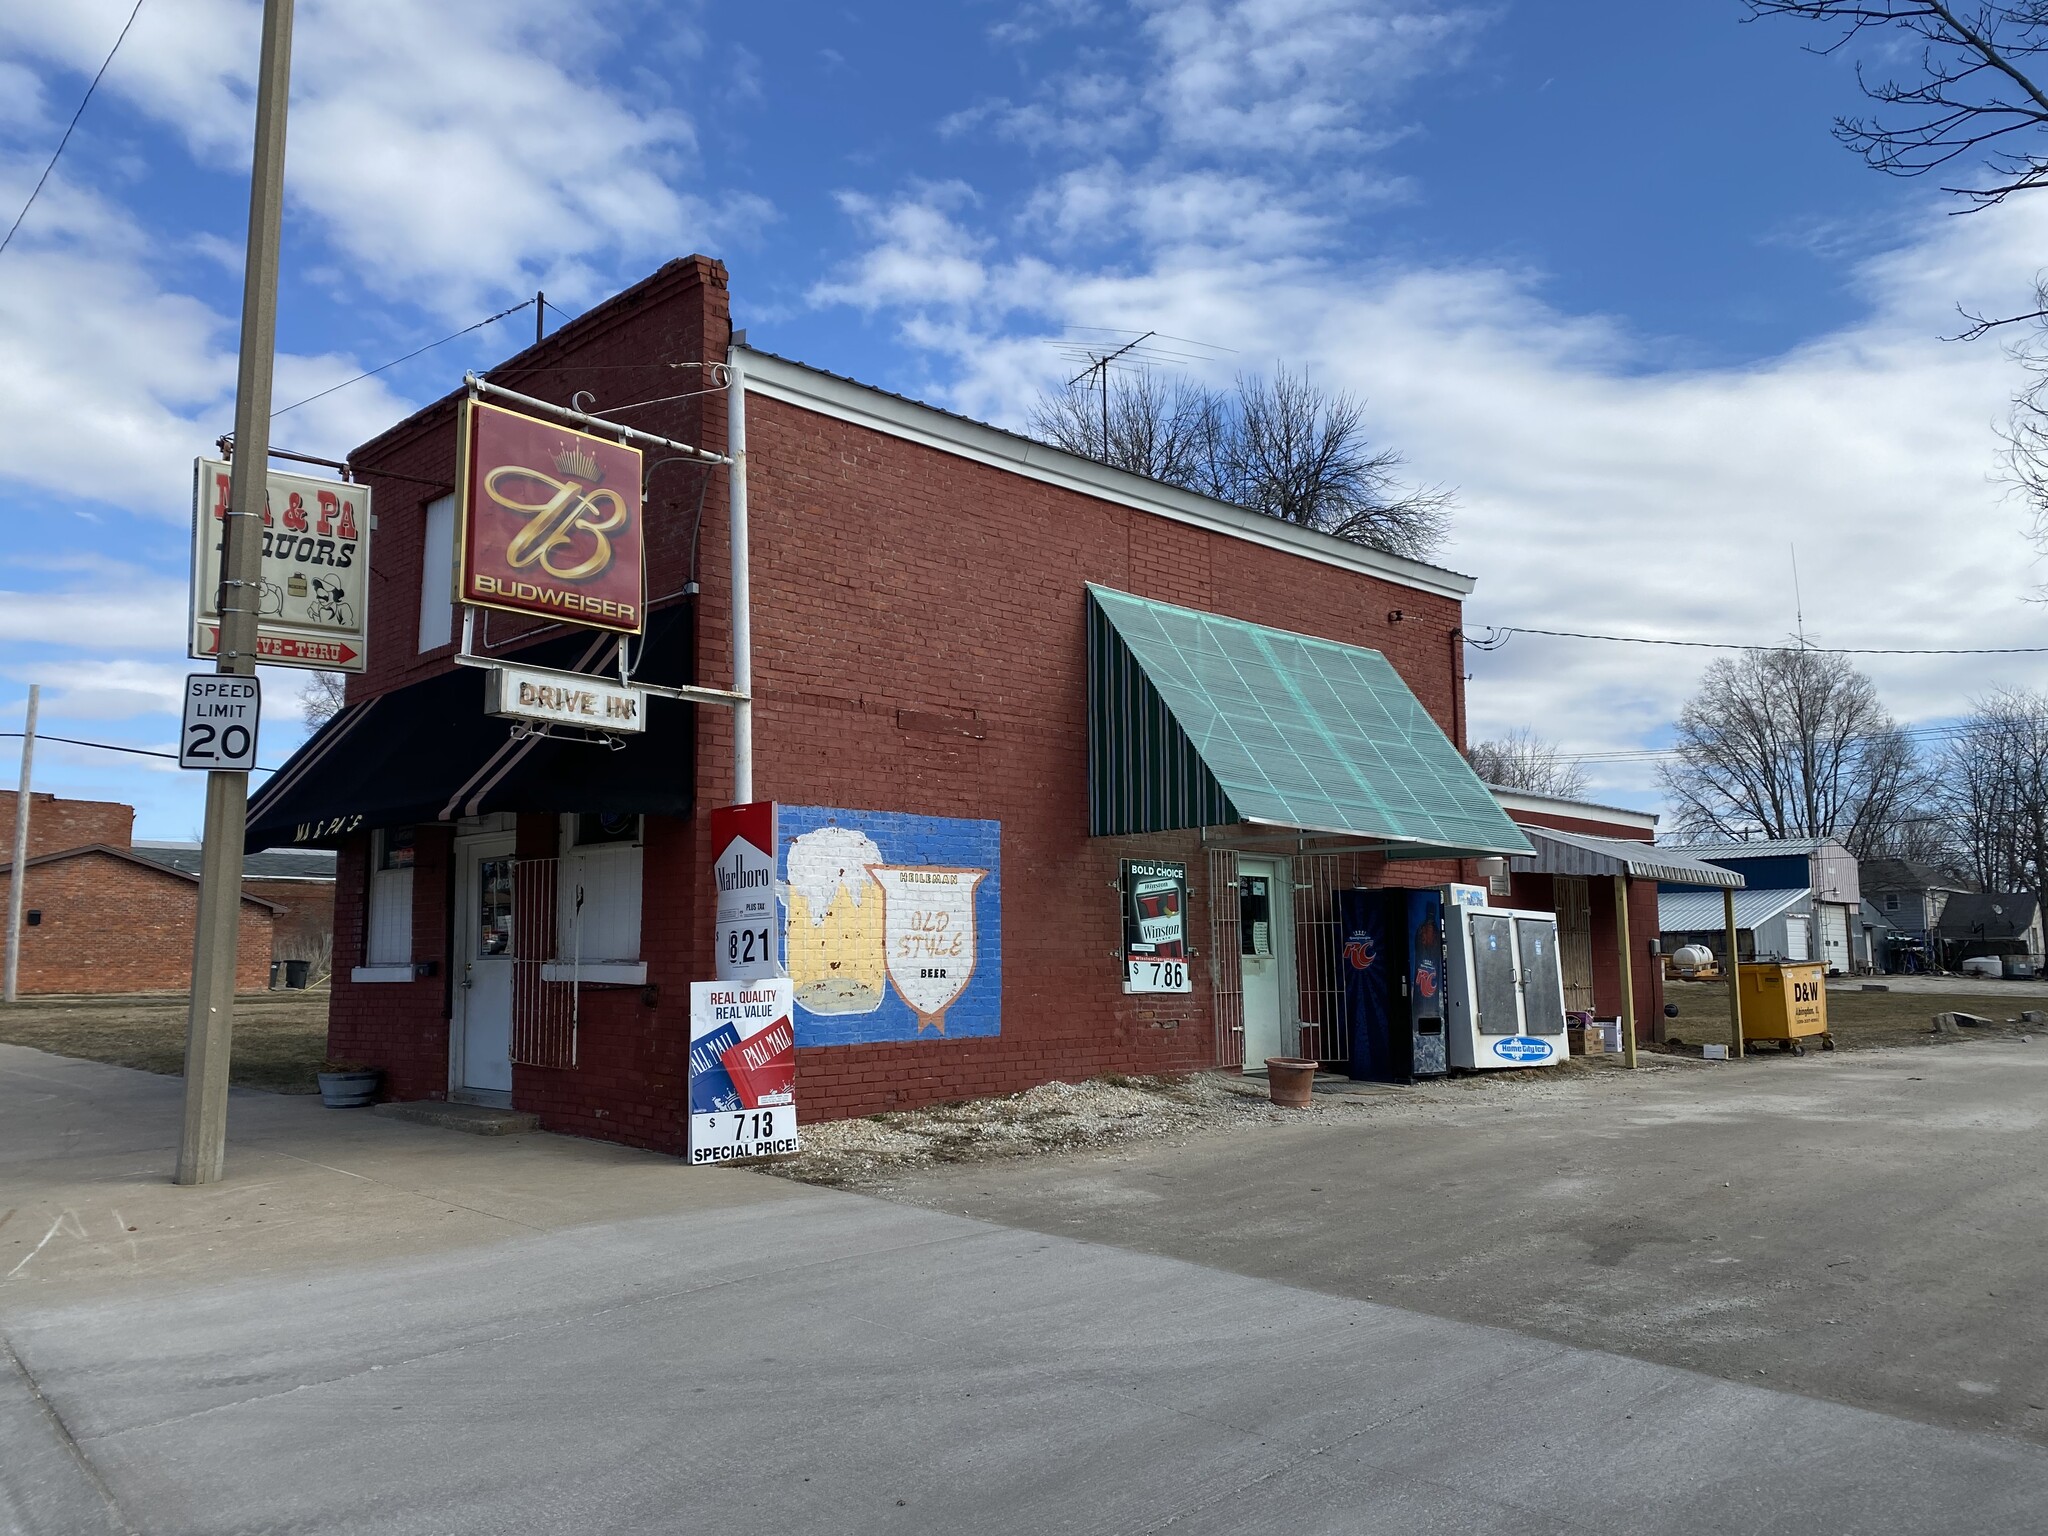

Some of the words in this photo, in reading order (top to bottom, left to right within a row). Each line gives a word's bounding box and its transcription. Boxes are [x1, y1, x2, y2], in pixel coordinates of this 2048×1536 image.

[282, 492, 309, 534] &
[316, 490, 358, 541] PA
[474, 574, 635, 621] BUDWEISER
[192, 683, 255, 698] SPEED
[519, 682, 596, 716] DRIVE
[606, 695, 637, 720] IN
[196, 704, 247, 718] LIMIT
[186, 724, 251, 759] 20
[717, 853, 769, 891] Marlboro
[900, 872, 959, 884] HEILEMAN
[1131, 865, 1155, 876] BOLD
[1156, 867, 1184, 879] CHOICE
[745, 903, 757, 911] PLUS
[757, 902, 766, 911] TAX
[911, 910, 950, 932] OLD
[1143, 924, 1180, 940] Winston
[897, 931, 962, 958] STYLE
[1342, 939, 1377, 970] RC
[920, 968, 947, 979] BEER
[1133, 962, 1139, 975] $
[1150, 962, 1183, 988] 7.86
[1415, 968, 1438, 998] RC
[710, 991, 737, 1005] REAL
[740, 990, 777, 1004] QUALITY
[1794, 981, 1818, 1002] D&W
[716, 1006, 742, 1020] REAL
[744, 1004, 773, 1018] VALUE
[742, 1040, 771, 1071] PALL
[765, 1025, 793, 1057] MALL
[1502, 1044, 1521, 1053] Home
[691, 1047, 714, 1078] ALL
[709, 1117, 716, 1128] $
[733, 1111, 773, 1141] 7.13
[694, 1144, 752, 1162] SPECIAL
[756, 1138, 797, 1155] PRICE!
